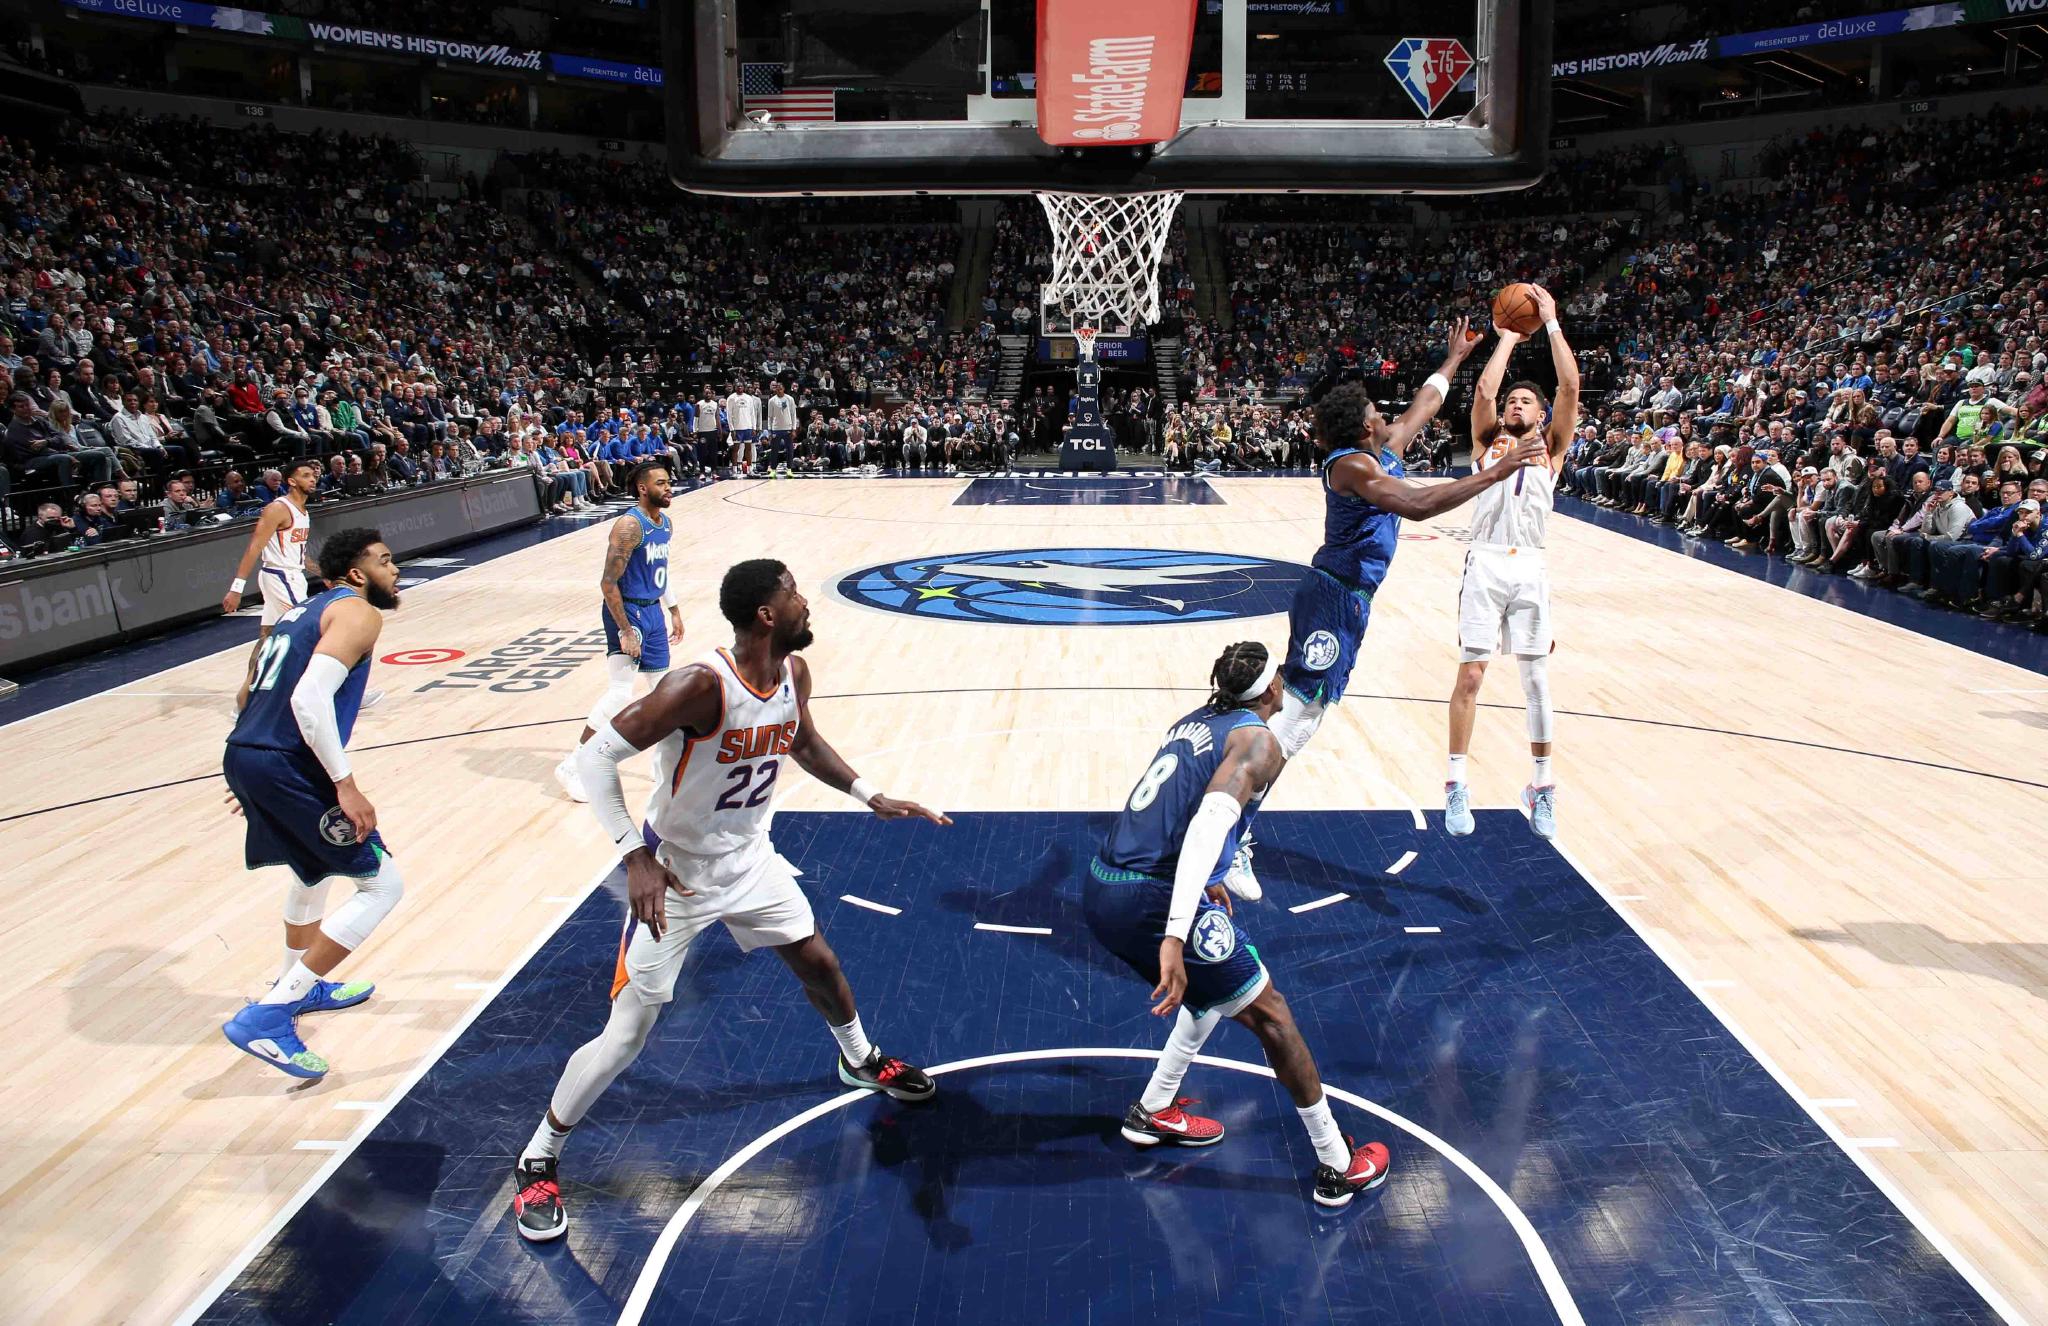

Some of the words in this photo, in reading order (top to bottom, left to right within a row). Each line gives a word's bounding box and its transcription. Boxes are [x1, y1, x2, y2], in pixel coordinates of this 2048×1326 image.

[113, 0, 182, 18] deluxe
[308, 22, 403, 50] WOMEN'S
[407, 36, 484, 60] HISTORY
[479, 44, 542, 71] Month
[1754, 36, 1798, 48] PRESENTED
[1799, 34, 1809, 42] BY
[1817, 19, 1877, 39] deluxe
[1438, 50, 1454, 74] 75
[1581, 51, 1649, 73] HISTORY
[1645, 38, 1710, 67] Month
[245, 106, 264, 116] 136
[1910, 102, 1928, 112] 106
[1069, 438, 1106, 451] TCL
[654, 566, 667, 589] 0
[413, 627, 580, 693] TARGET
[715, 720, 797, 764] SUNS
[714, 759, 780, 812] 22
[1129, 752, 1179, 812] 8
